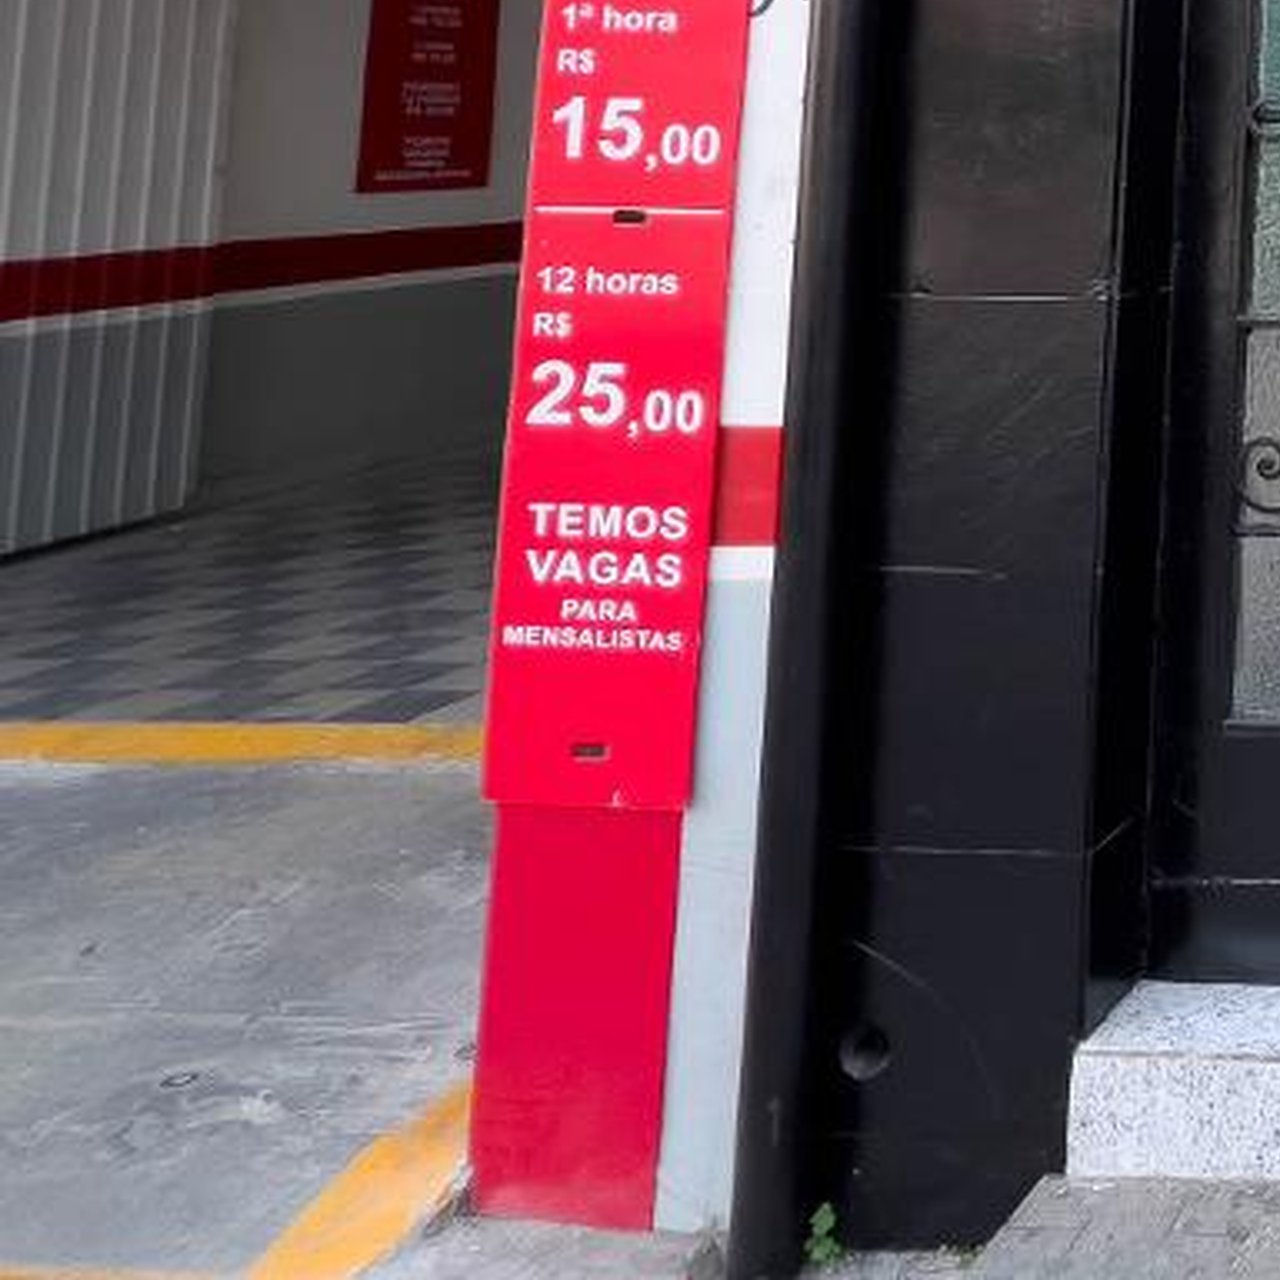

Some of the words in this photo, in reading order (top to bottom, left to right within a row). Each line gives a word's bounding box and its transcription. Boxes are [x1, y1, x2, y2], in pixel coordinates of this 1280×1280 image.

[561, 3, 594, 32] 1ª
[602, 4, 679, 33] hora
[556, 49, 597, 75] R$
[551, 95, 722, 172] 15,00
[535, 267, 577, 295] 12
[585, 267, 681, 296] horas
[532, 312, 574, 339] R$
[524, 359, 705, 439] 25,00
[528, 503, 689, 542] TEMOS
[526, 550, 684, 589] VAGAS
[559, 598, 637, 623] PARA
[501, 625, 684, 653] MENSALISTAS
